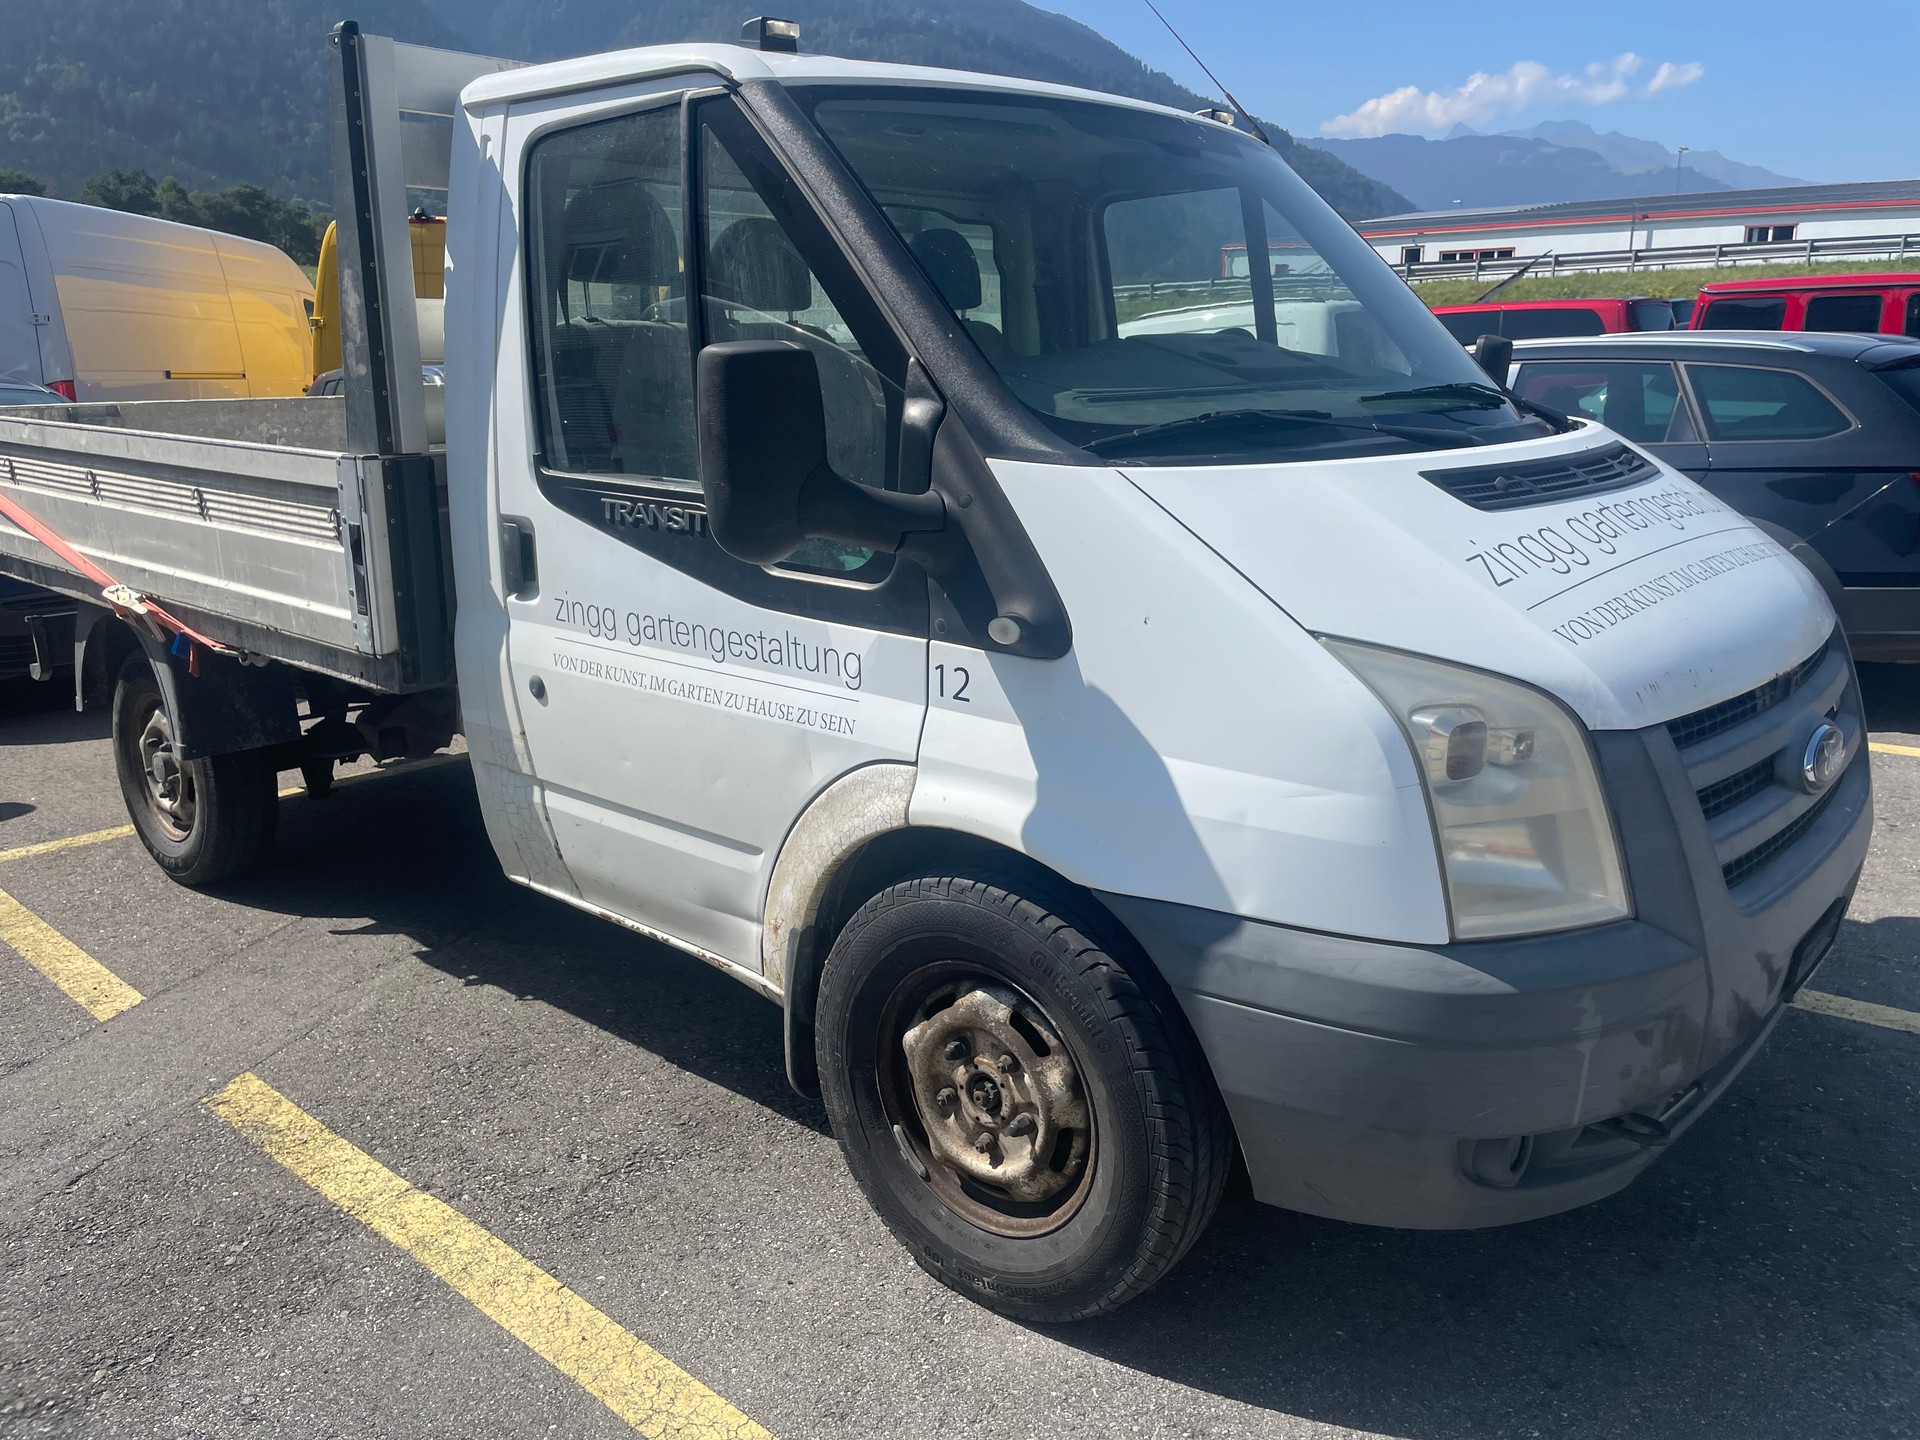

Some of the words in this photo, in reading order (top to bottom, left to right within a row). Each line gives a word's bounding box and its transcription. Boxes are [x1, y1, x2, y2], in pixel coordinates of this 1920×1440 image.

[601, 498, 707, 533] TRANSIT
[1465, 526, 1590, 587] zingg
[554, 590, 617, 641] zingg
[626, 614, 862, 690] gartengestaltung
[1552, 611, 1606, 646] VON
[1592, 597, 1640, 626] DER
[1623, 575, 1687, 610] KUNST,
[553, 653, 578, 672] VON
[580, 660, 604, 679] DER
[604, 665, 647, 690] KUNST,
[649, 675, 667, 693] IM
[668, 680, 723, 705] GARTEN
[724, 692, 745, 710] ZU
[746, 697, 795, 722] HAUSE
[796, 707, 819, 727] ZU
[820, 712, 857, 735] SEIN
[935, 664, 970, 702] 12
